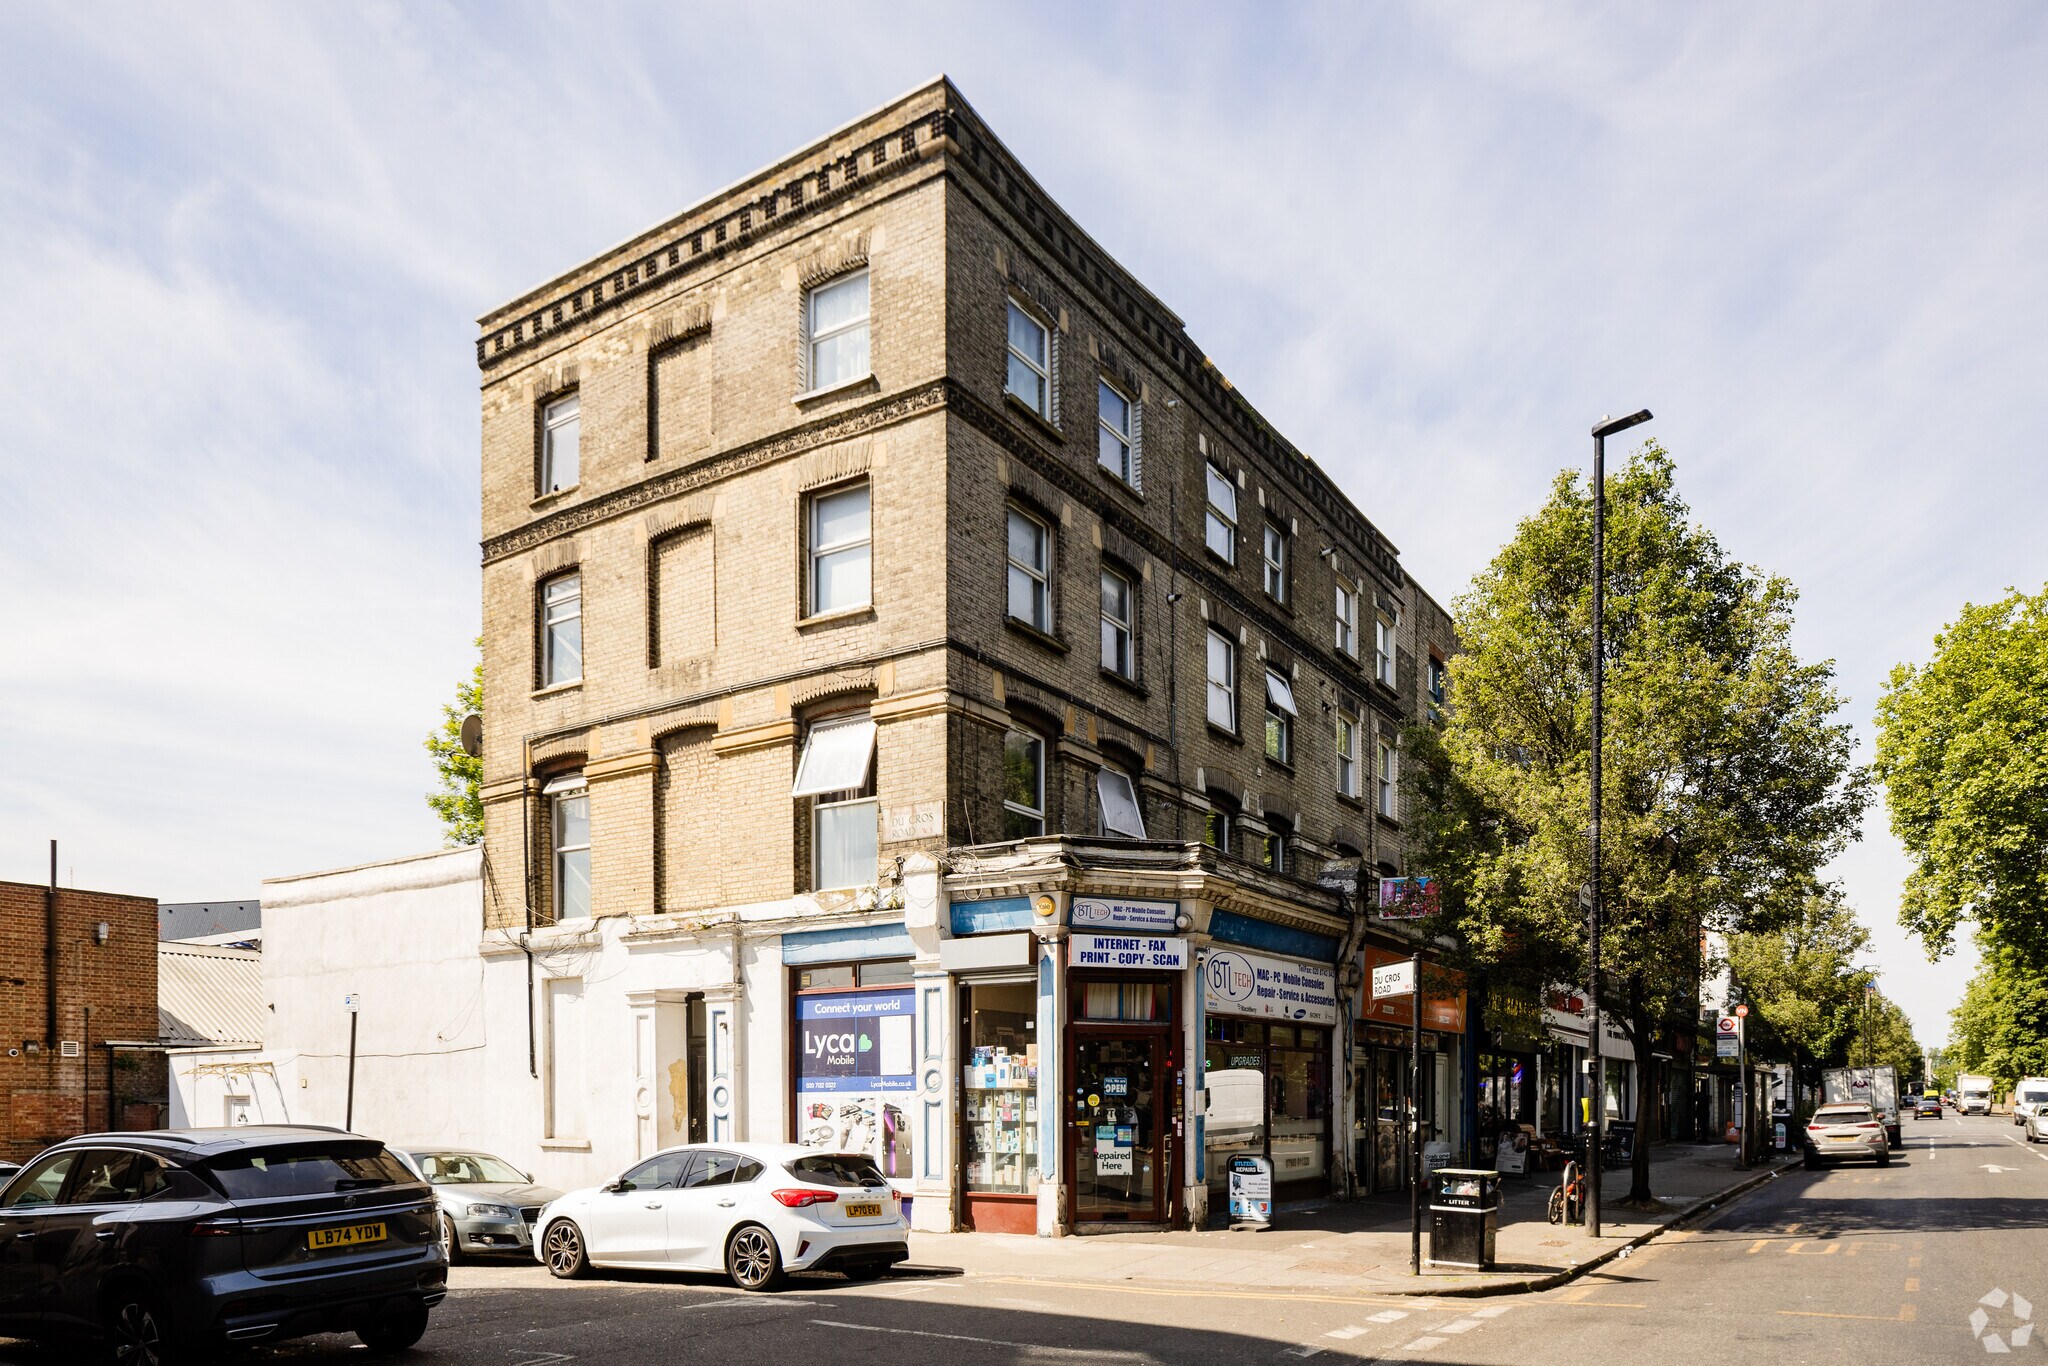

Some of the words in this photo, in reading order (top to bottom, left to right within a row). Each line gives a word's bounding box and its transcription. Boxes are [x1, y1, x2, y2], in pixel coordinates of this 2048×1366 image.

[892, 817, 904, 827] DU
[909, 812, 934, 824] CROS
[892, 827, 916, 839] ROAD
[1038, 902, 1051, 910] Yale
[1094, 908, 1108, 916] TECH
[1093, 938, 1140, 951] INTERNET
[1148, 940, 1166, 952] FAX
[1080, 951, 1110, 964] PRINT
[1118, 953, 1145, 965] COPY
[1153, 953, 1180, 966] SCAN
[1234, 971, 1252, 989] TECH
[1256, 967, 1270, 981] MAC
[1273, 971, 1281, 983] PC
[1283, 972, 1301, 986] Mobile
[1302, 975, 1325, 991] Consoles
[1374, 976, 1383, 985] DU
[1384, 973, 1401, 983] CROS
[1256, 985, 1276, 999] Repair
[1279, 988, 1300, 1002] Service
[1301, 994, 1304, 1002] &
[1305, 992, 1335, 1007] Accessories
[1374, 985, 1392, 995] ROAD
[815, 1003, 850, 1014] Connect
[852, 1004, 873, 1014] your
[874, 999, 901, 1011] world
[805, 1030, 855, 1058] Lyca
[826, 1055, 855, 1065] Mobile
[1230, 1055, 1261, 1067] UPGRADES
[1105, 1084, 1126, 1093] OPEN
[1094, 1151, 1131, 1161] Repaired
[1101, 1162, 1123, 1170] Here
[1428, 1160, 1445, 1168] meal
[315, 1228, 352, 1246] LB74
[355, 1224, 381, 1240] YDW
